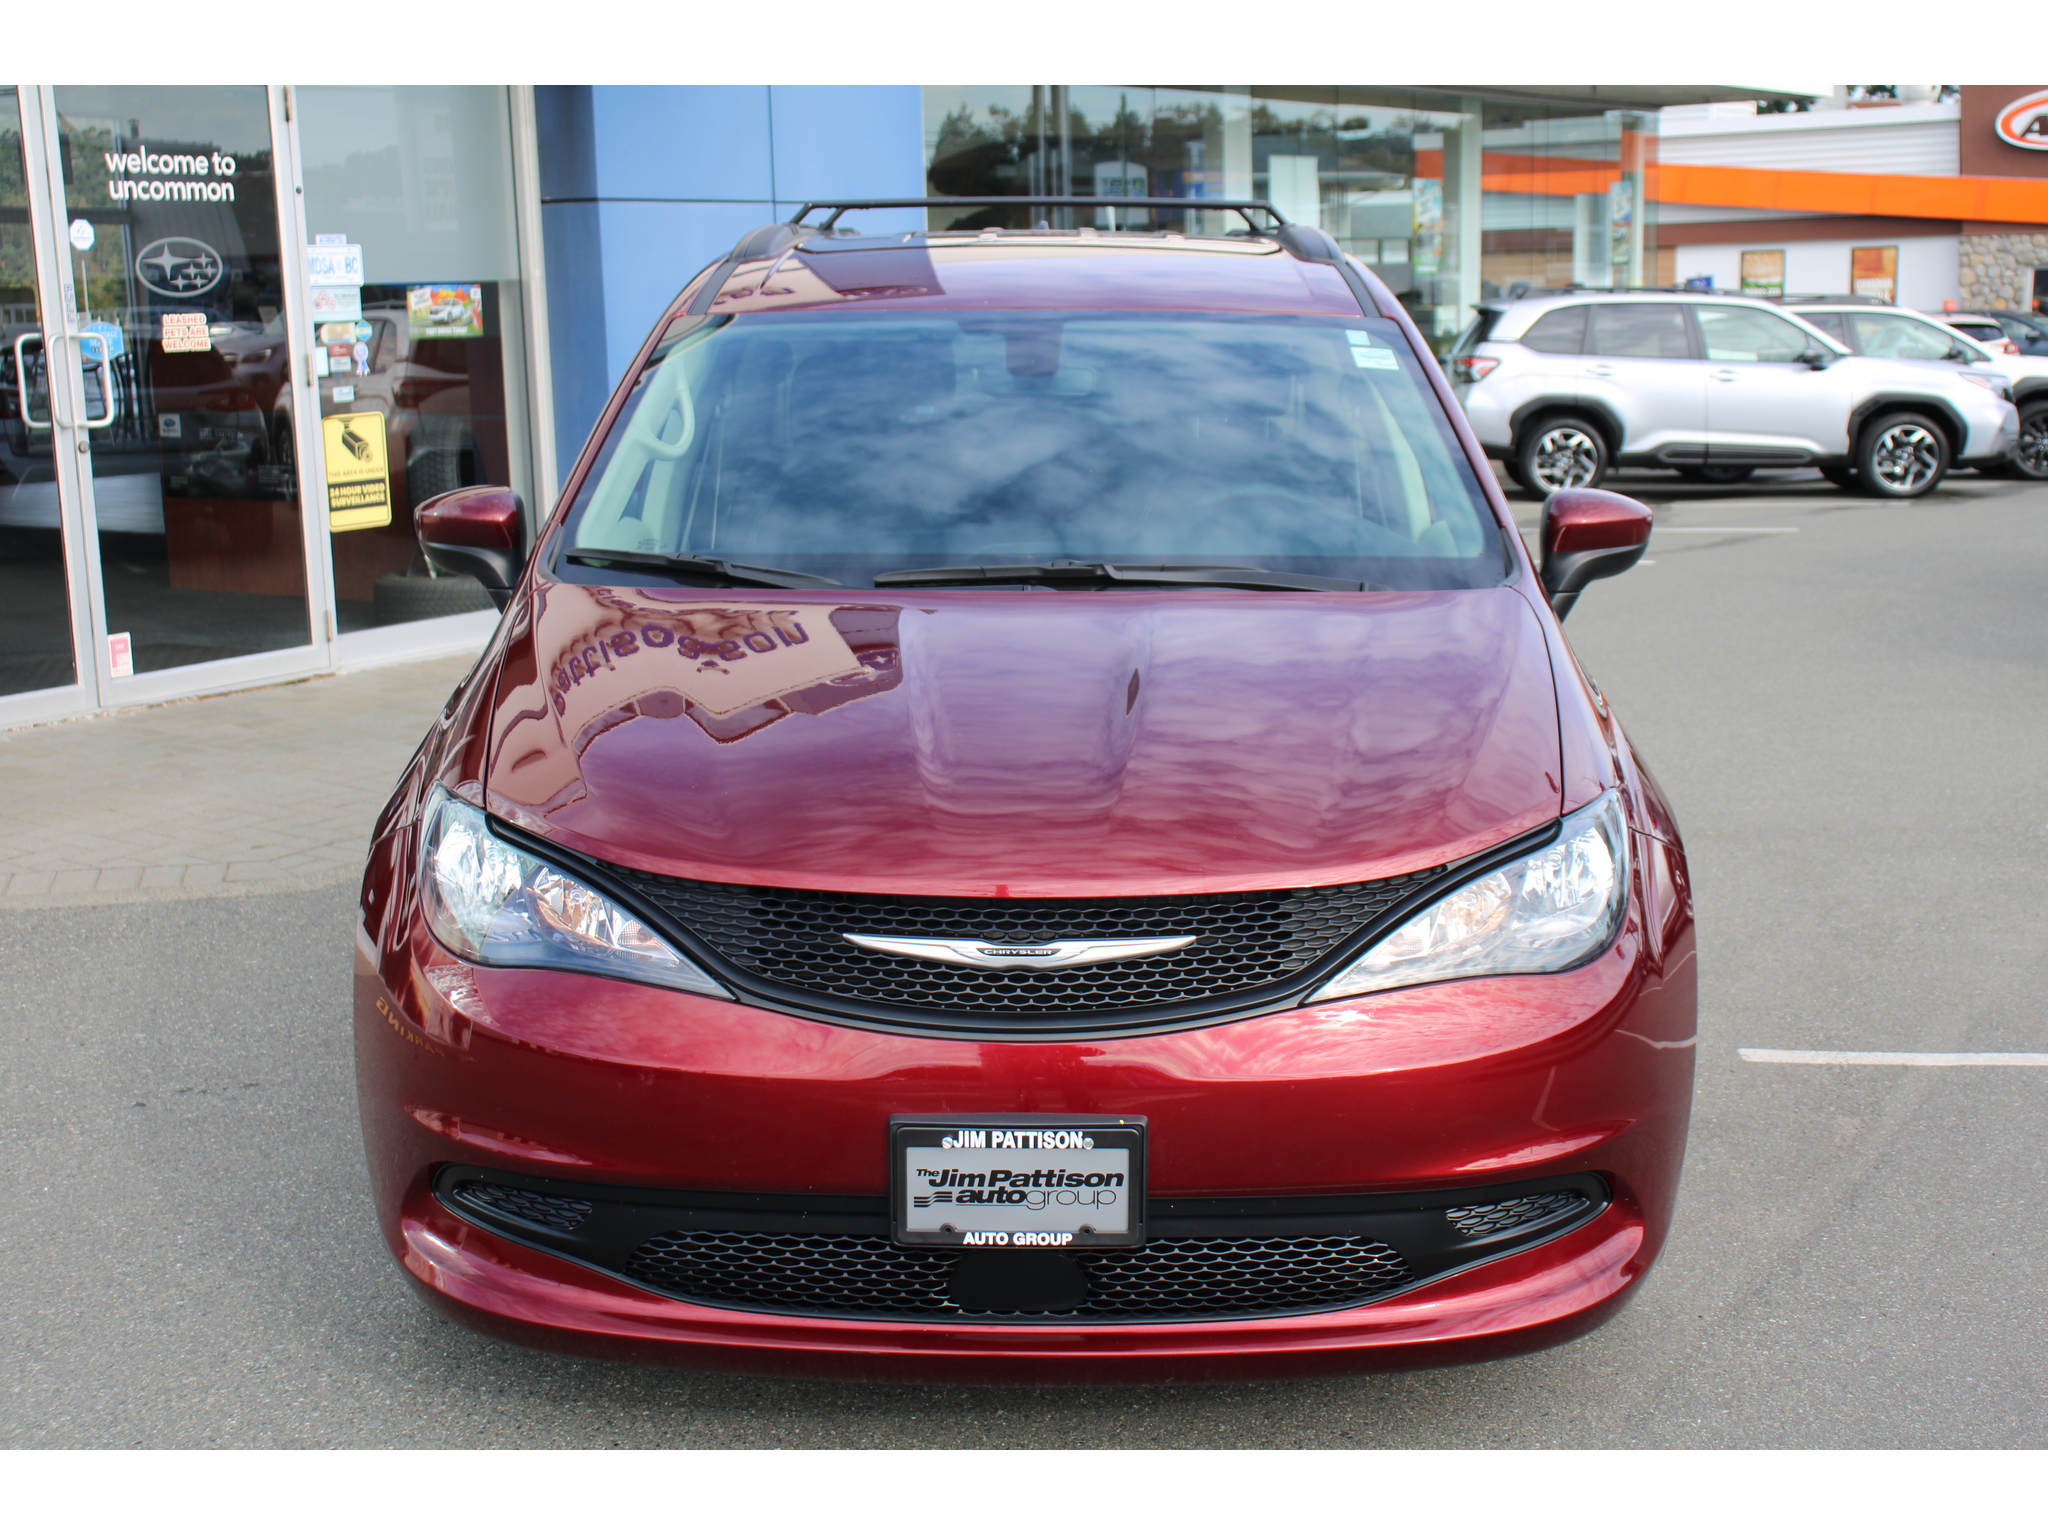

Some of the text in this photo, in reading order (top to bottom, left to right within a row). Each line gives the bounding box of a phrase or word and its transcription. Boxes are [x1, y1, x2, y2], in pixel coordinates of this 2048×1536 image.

[105, 145, 236, 176] welcome to
[108, 179, 235, 202] uncommon
[64, 284, 76, 323] PULL
[164, 314, 206, 325] LEASHED
[164, 326, 208, 337] PETS ARE
[164, 338, 210, 349] WELCOME
[329, 470, 341, 478] THIS
[365, 466, 385, 474] UNDER
[330, 481, 386, 498] 24 HOUR VIDEO
[331, 492, 386, 509] SURVEILLANCE
[953, 1130, 1084, 1149] JIM PATTISON
[916, 1168, 940, 1177] The
[963, 1232, 1073, 1246] AUTO GROUP
